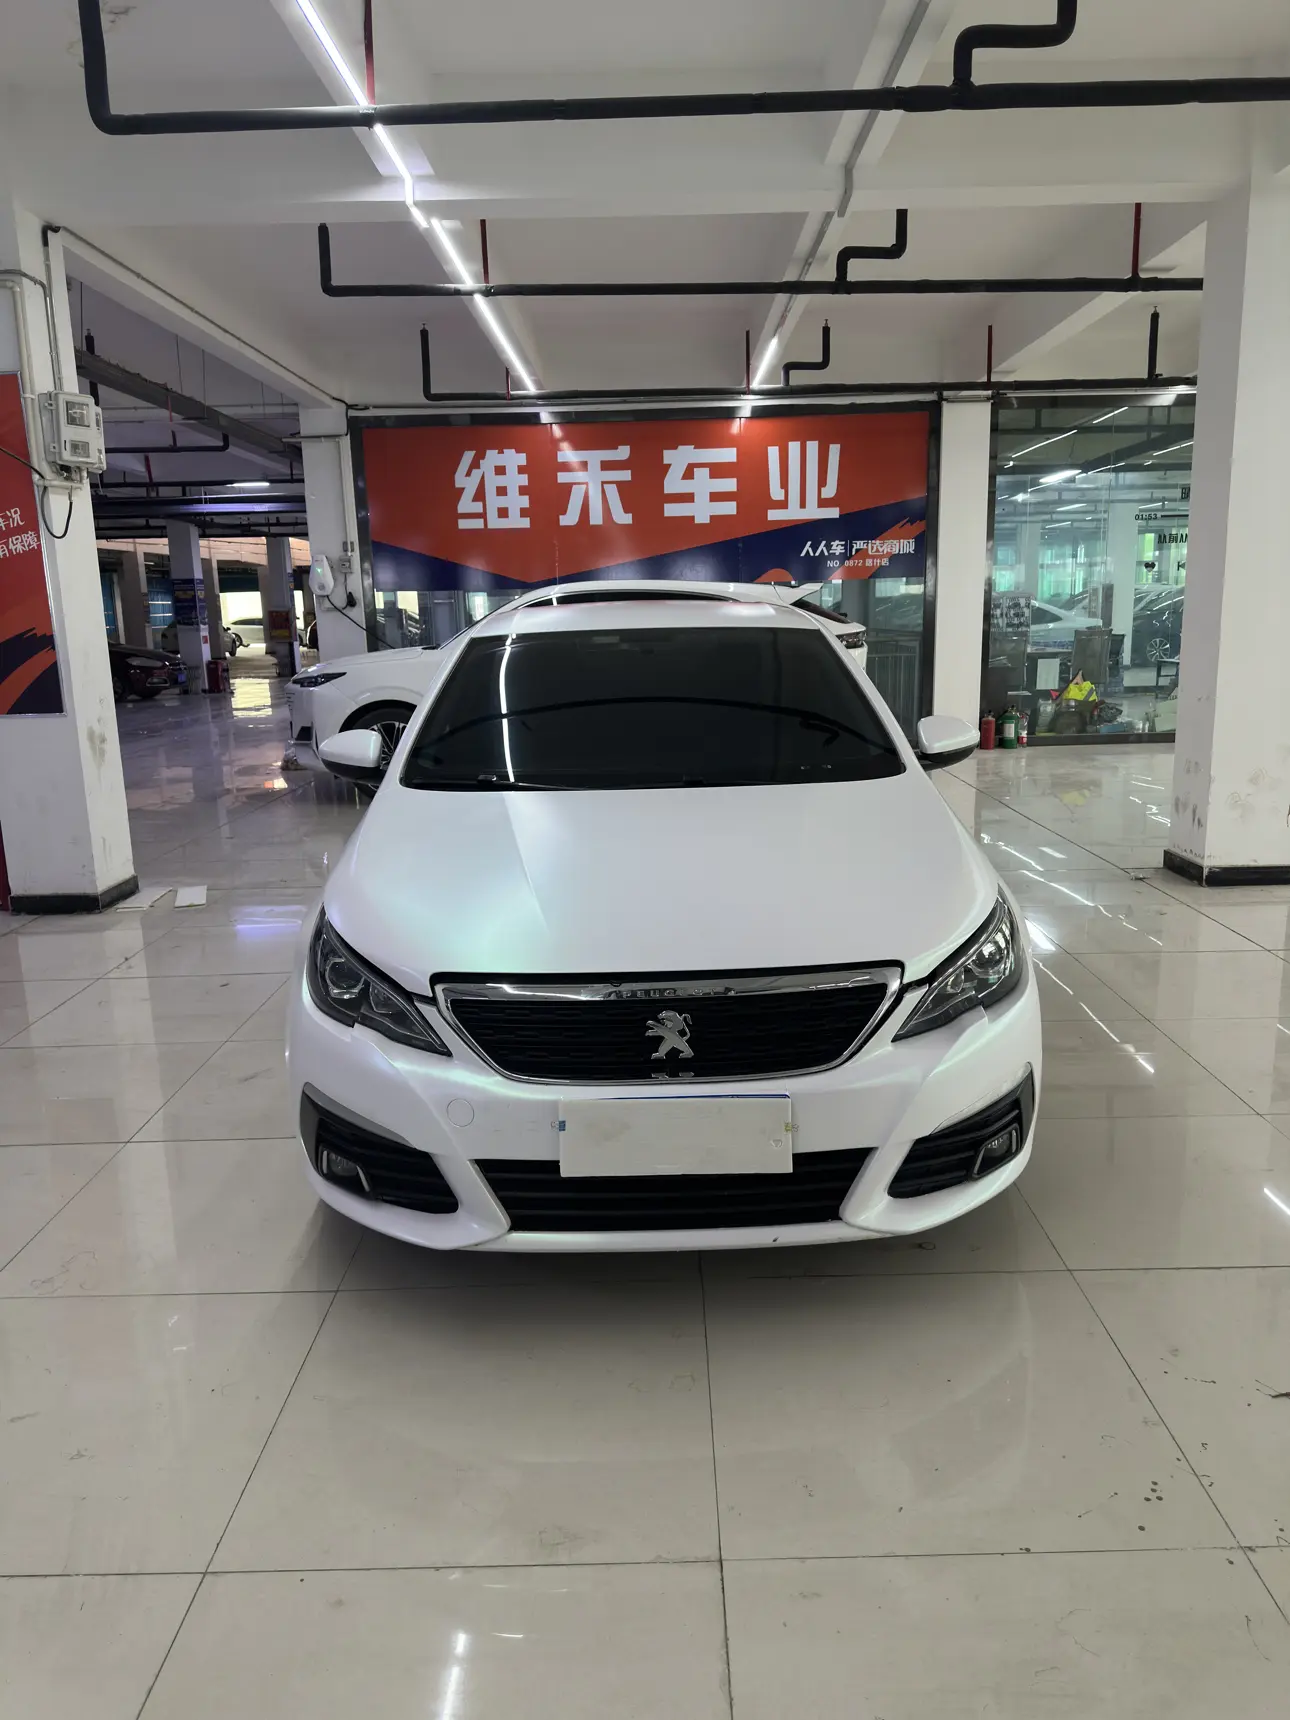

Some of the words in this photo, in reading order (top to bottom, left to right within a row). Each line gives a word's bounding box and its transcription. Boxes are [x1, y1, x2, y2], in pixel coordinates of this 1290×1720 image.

[454, 440, 841, 530] 维禾车业
[1134, 513, 1158, 521] 01:53
[800, 540, 846, 557] 人人车
[851, 538, 916, 556] 严选商城
[844, 559, 863, 567] 0872
